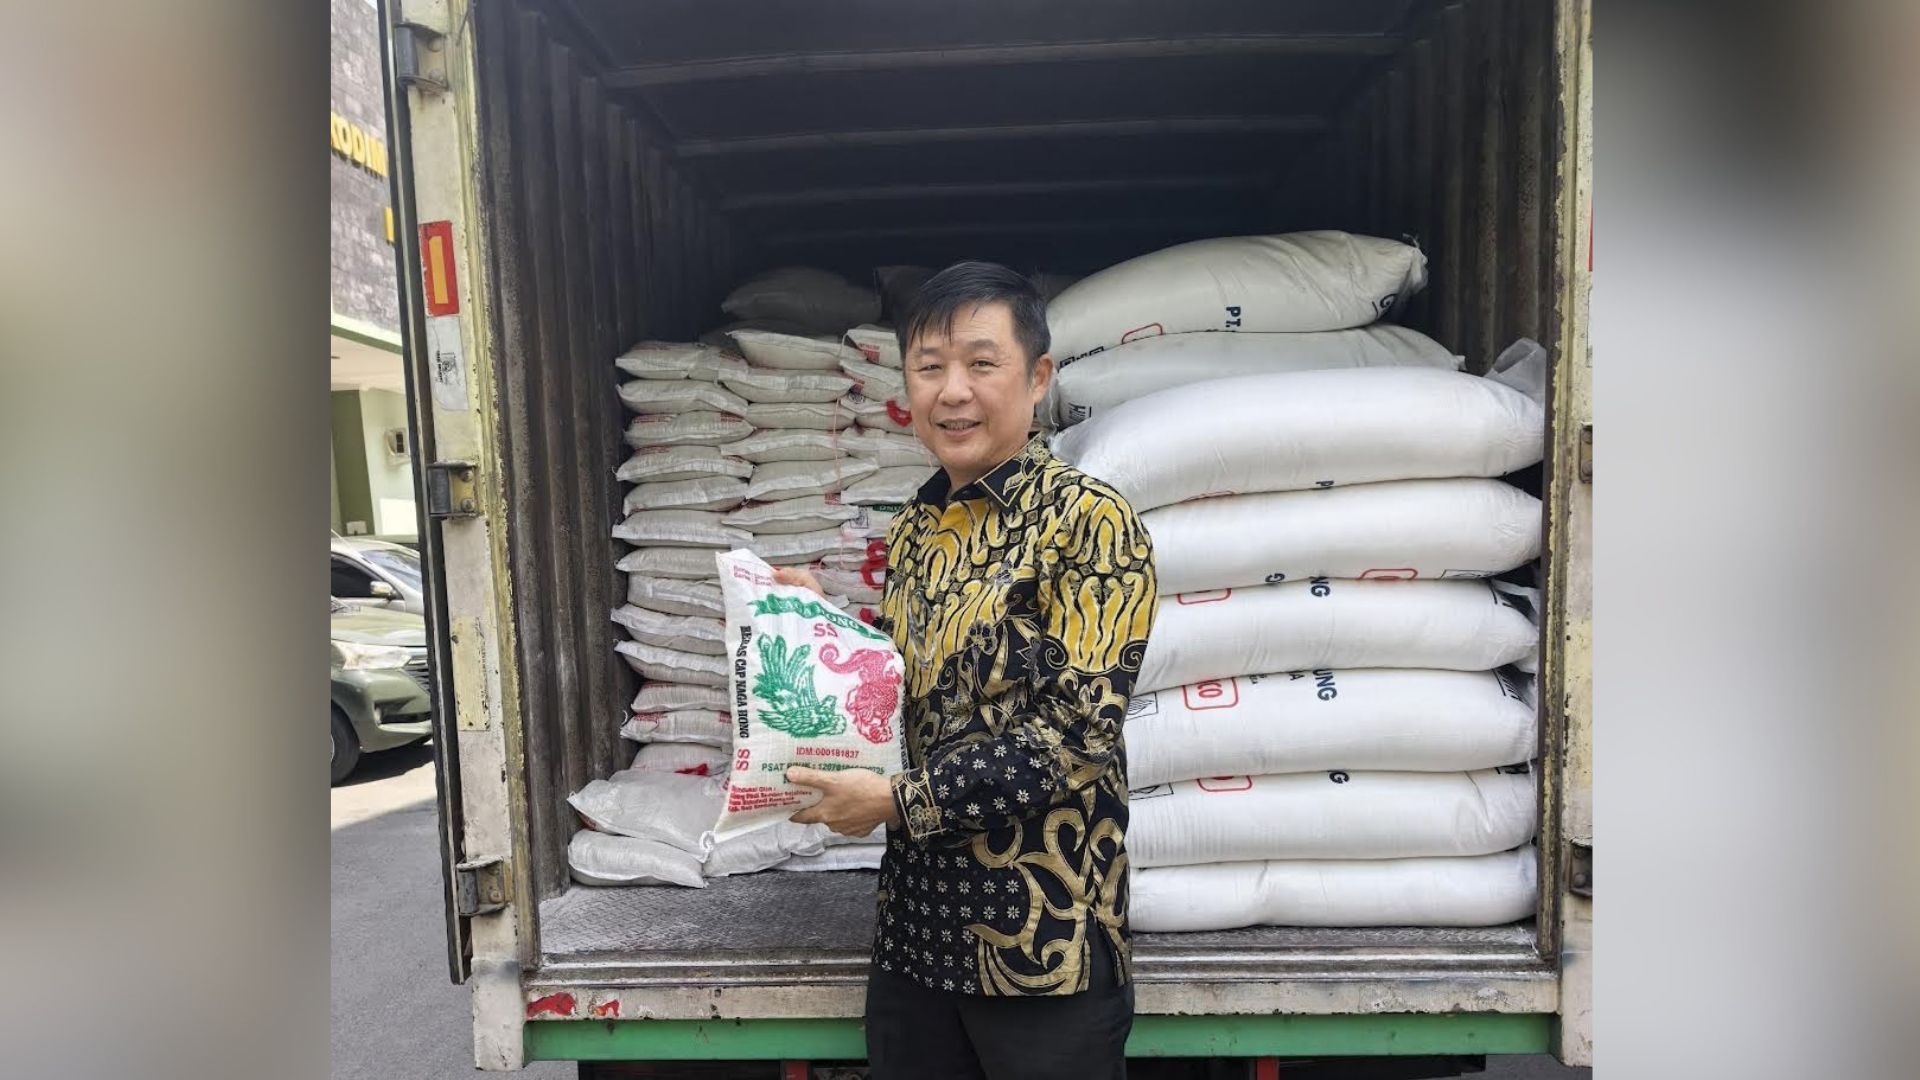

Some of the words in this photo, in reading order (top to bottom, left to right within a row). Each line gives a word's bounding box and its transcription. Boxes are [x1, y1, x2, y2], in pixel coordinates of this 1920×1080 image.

[1226, 306, 1241, 328] PT.
[735, 659, 747, 679] CAP
[736, 680, 748, 707] NAGA
[738, 710, 749, 739] HONG
[735, 748, 750, 771] SS
[762, 762, 783, 772] PSAT
